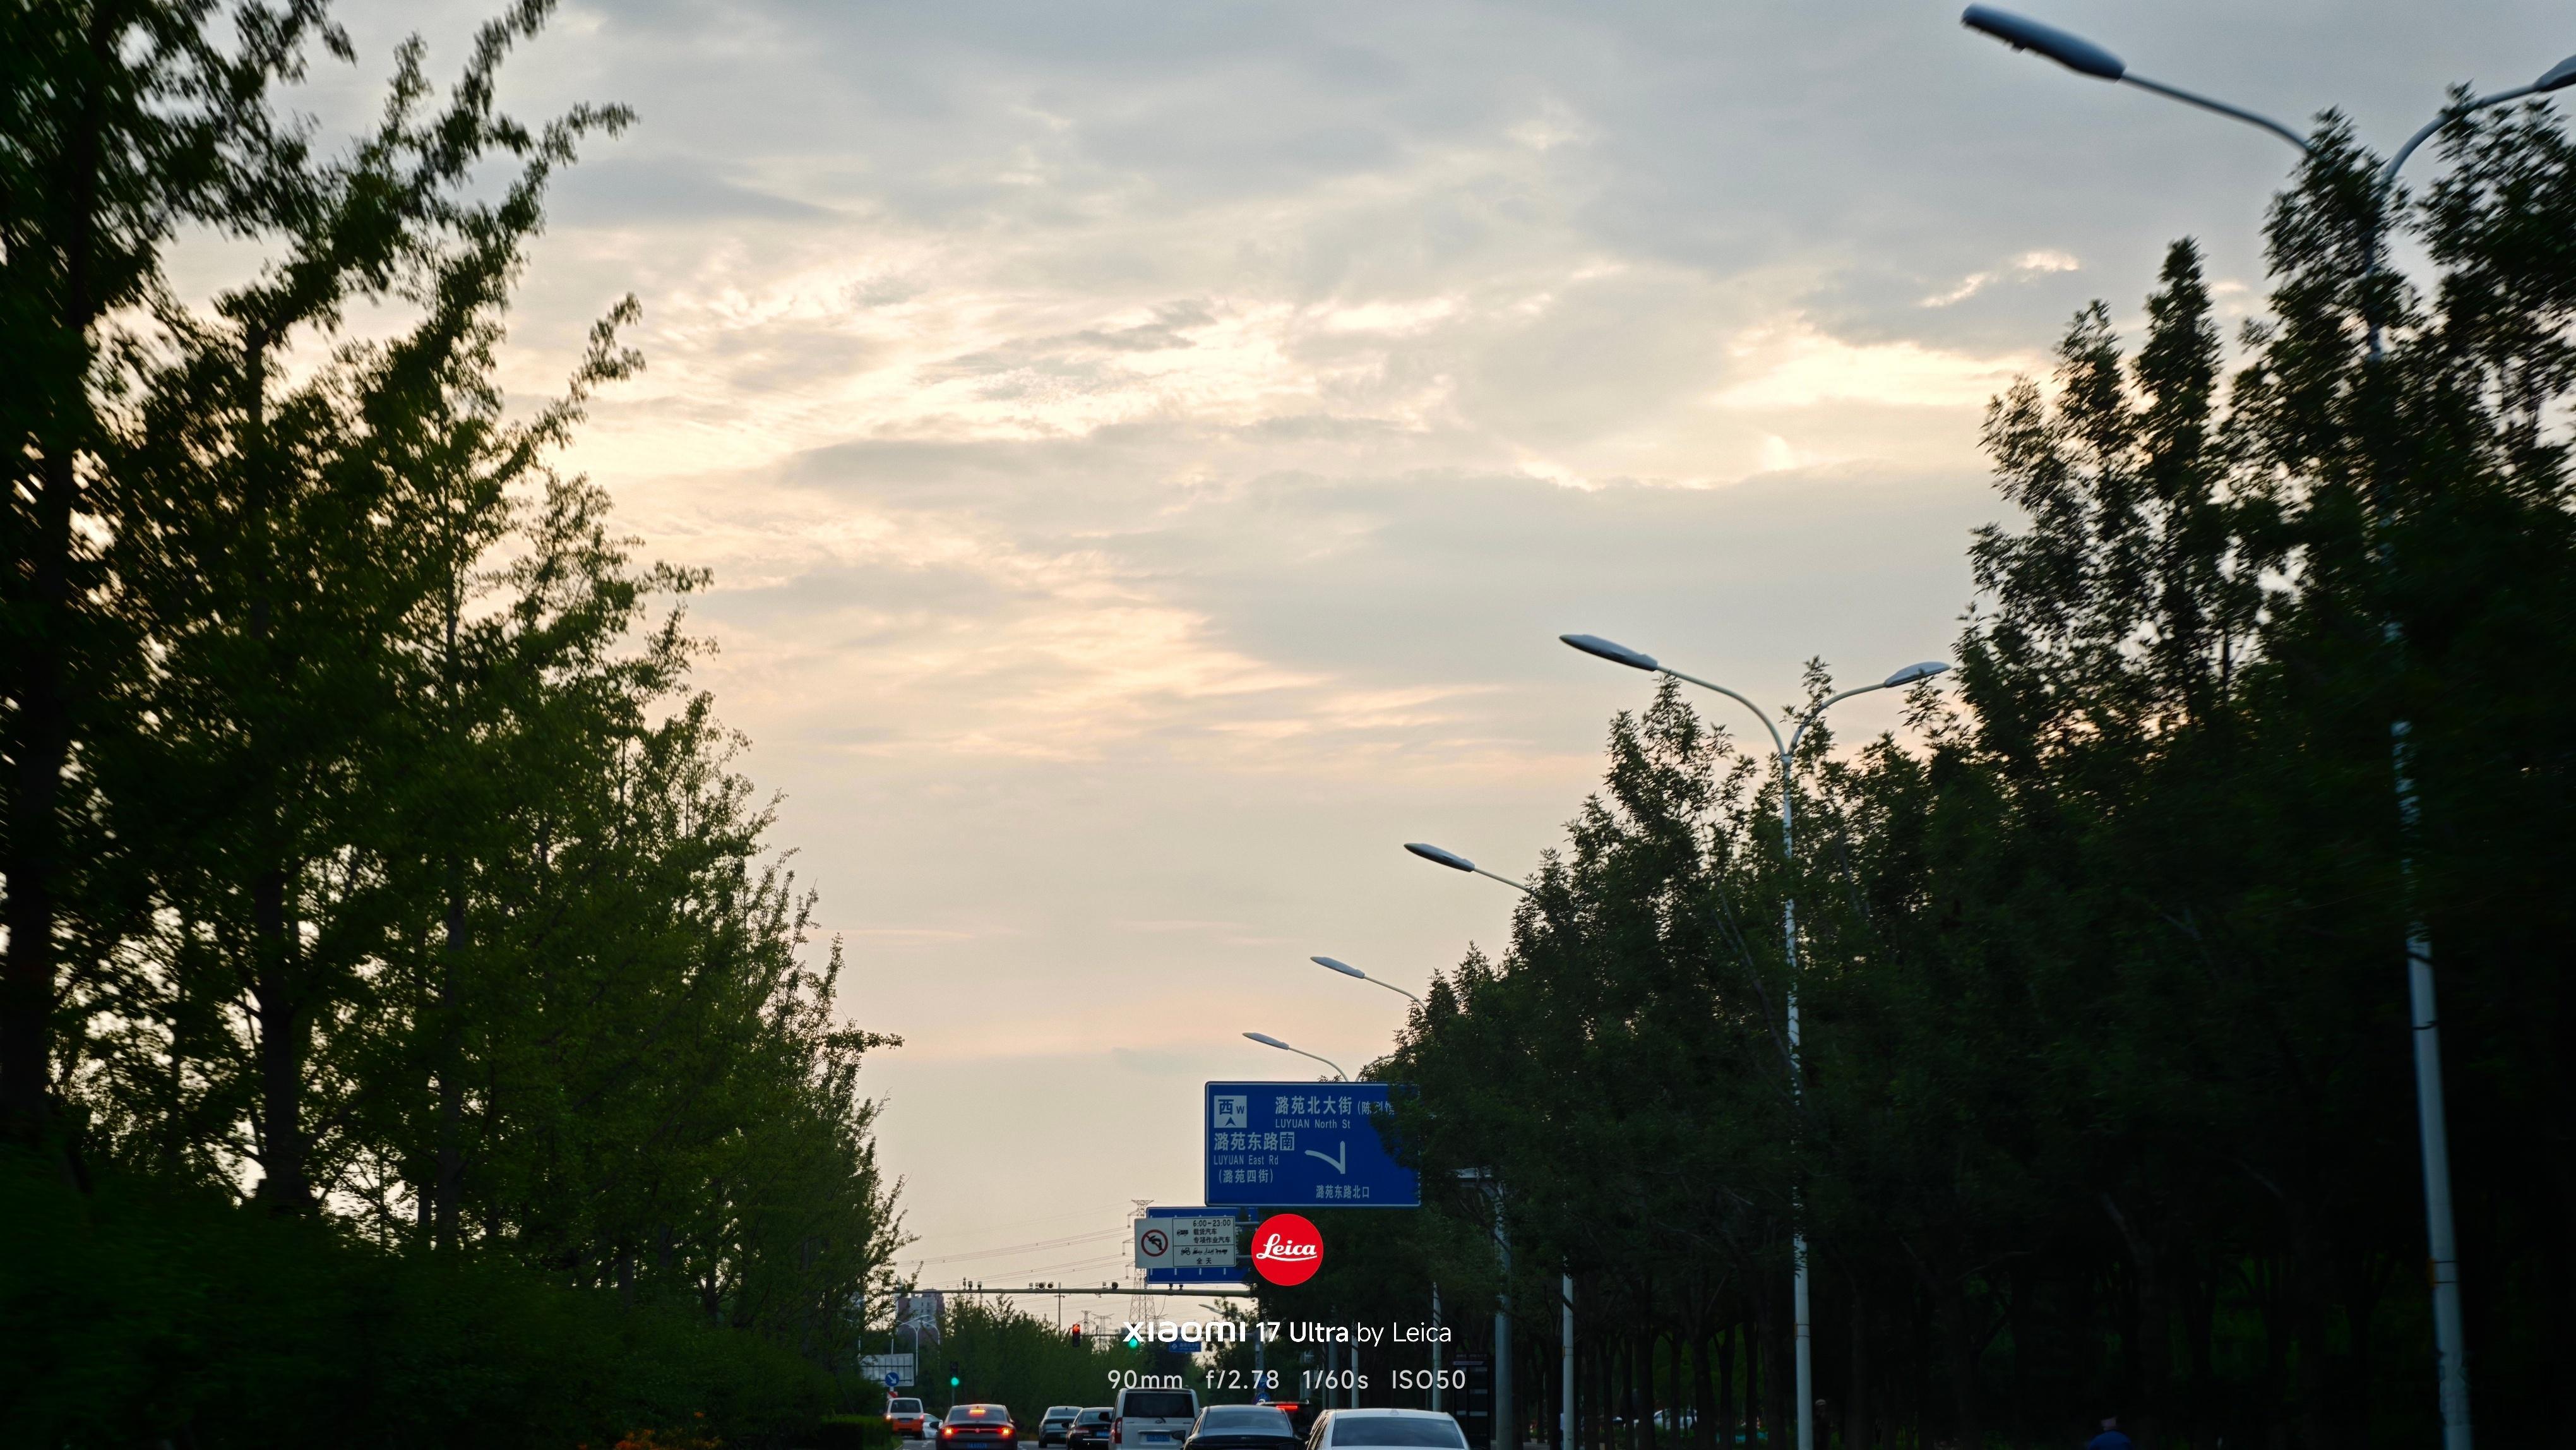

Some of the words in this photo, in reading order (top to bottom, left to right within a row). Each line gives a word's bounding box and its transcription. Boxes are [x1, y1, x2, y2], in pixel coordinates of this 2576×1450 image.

[1218, 1099, 1234, 1115] 西
[1236, 1106, 1244, 1114] W
[1275, 1096, 1352, 1115] 潞苑北大街
[1275, 1119, 1309, 1128] LUYUAN
[1315, 1119, 1337, 1129] North
[1342, 1119, 1351, 1129] St
[1213, 1155, 1244, 1165] LUYUAN
[1249, 1155, 1264, 1165] East
[1269, 1155, 1279, 1165] Rd
[1219, 1168, 1273, 1183] (潞苑四街)
[1316, 1185, 1369, 1199] 潞苑东路北口
